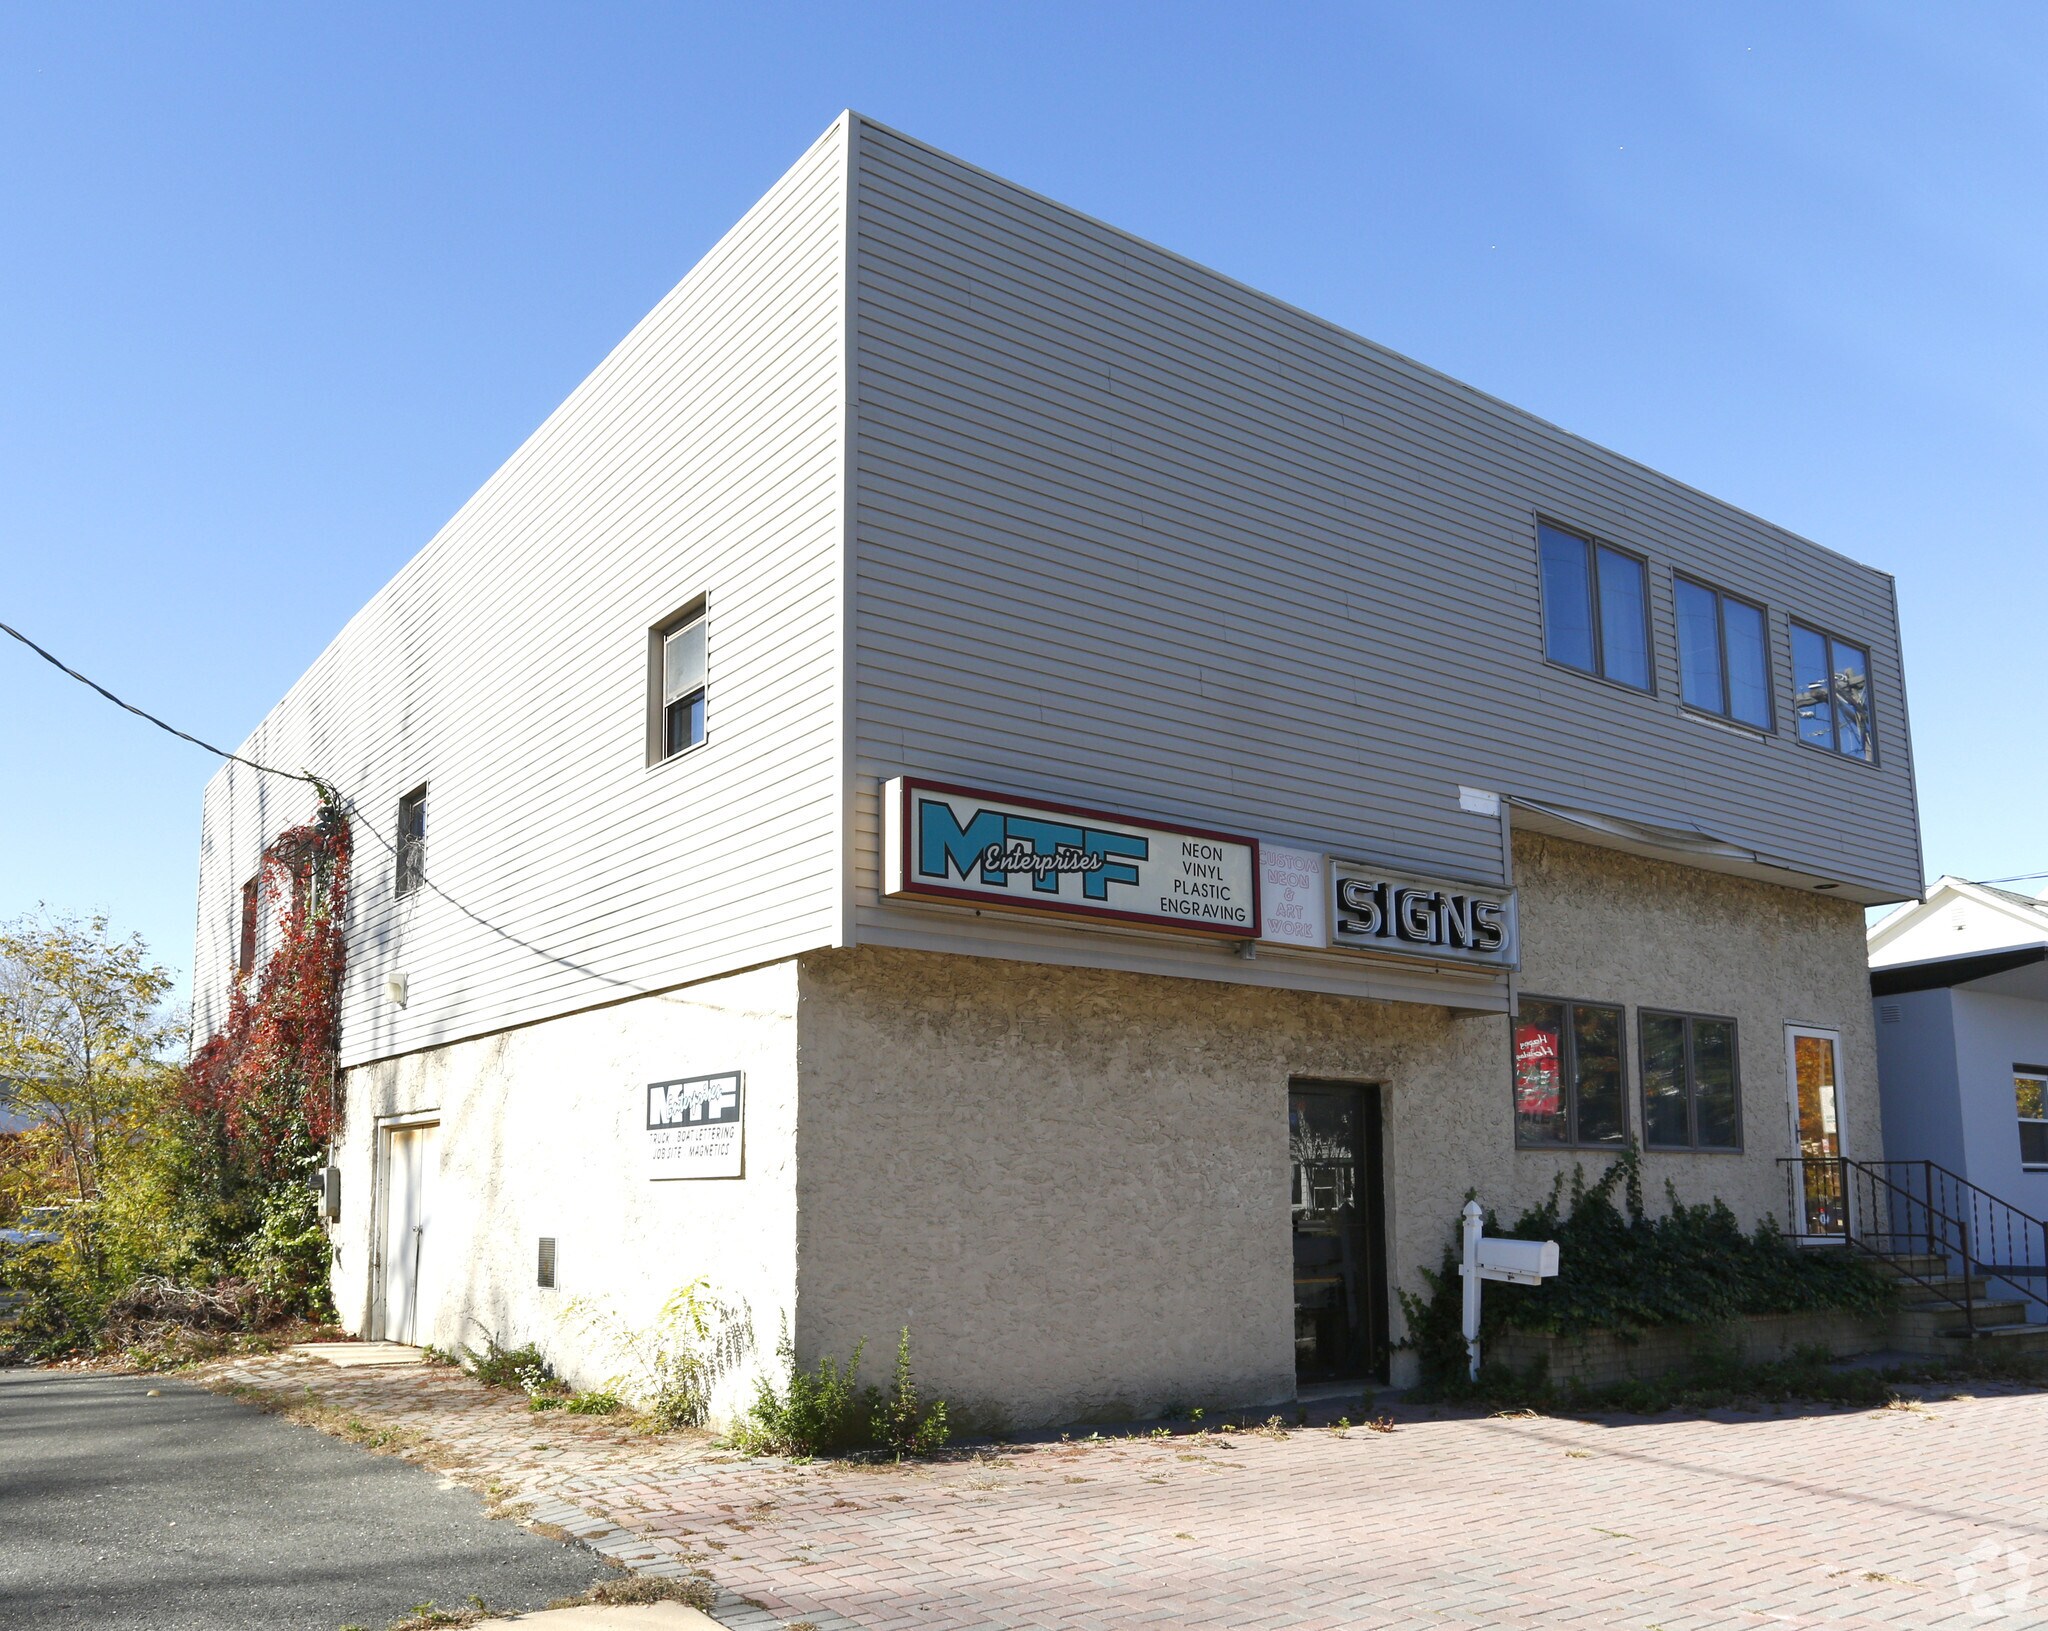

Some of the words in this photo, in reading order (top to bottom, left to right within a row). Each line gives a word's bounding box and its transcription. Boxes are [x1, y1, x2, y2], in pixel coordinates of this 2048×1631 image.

[919, 797, 1149, 901] MTF
[1182, 842, 1222, 861] NEON
[984, 845, 1103, 879] Enterprises
[1183, 861, 1223, 881] VINYL
[1259, 849, 1319, 874] CUSTOM
[1268, 869, 1310, 889] NEON
[1174, 879, 1231, 901] PLASTIC
[1283, 887, 1295, 901] &
[1160, 897, 1246, 922] ENGRAVING
[1275, 902, 1303, 919] ART
[1337, 877, 1510, 952] SIGNS
[1267, 918, 1313, 938] WORK
[649, 1076, 737, 1125] MTF
[649, 1131, 671, 1144] TRUCK
[677, 1128, 694, 1143] BOAT
[695, 1126, 735, 1141] LETTERING
[689, 1143, 730, 1157] MAGNETICS
